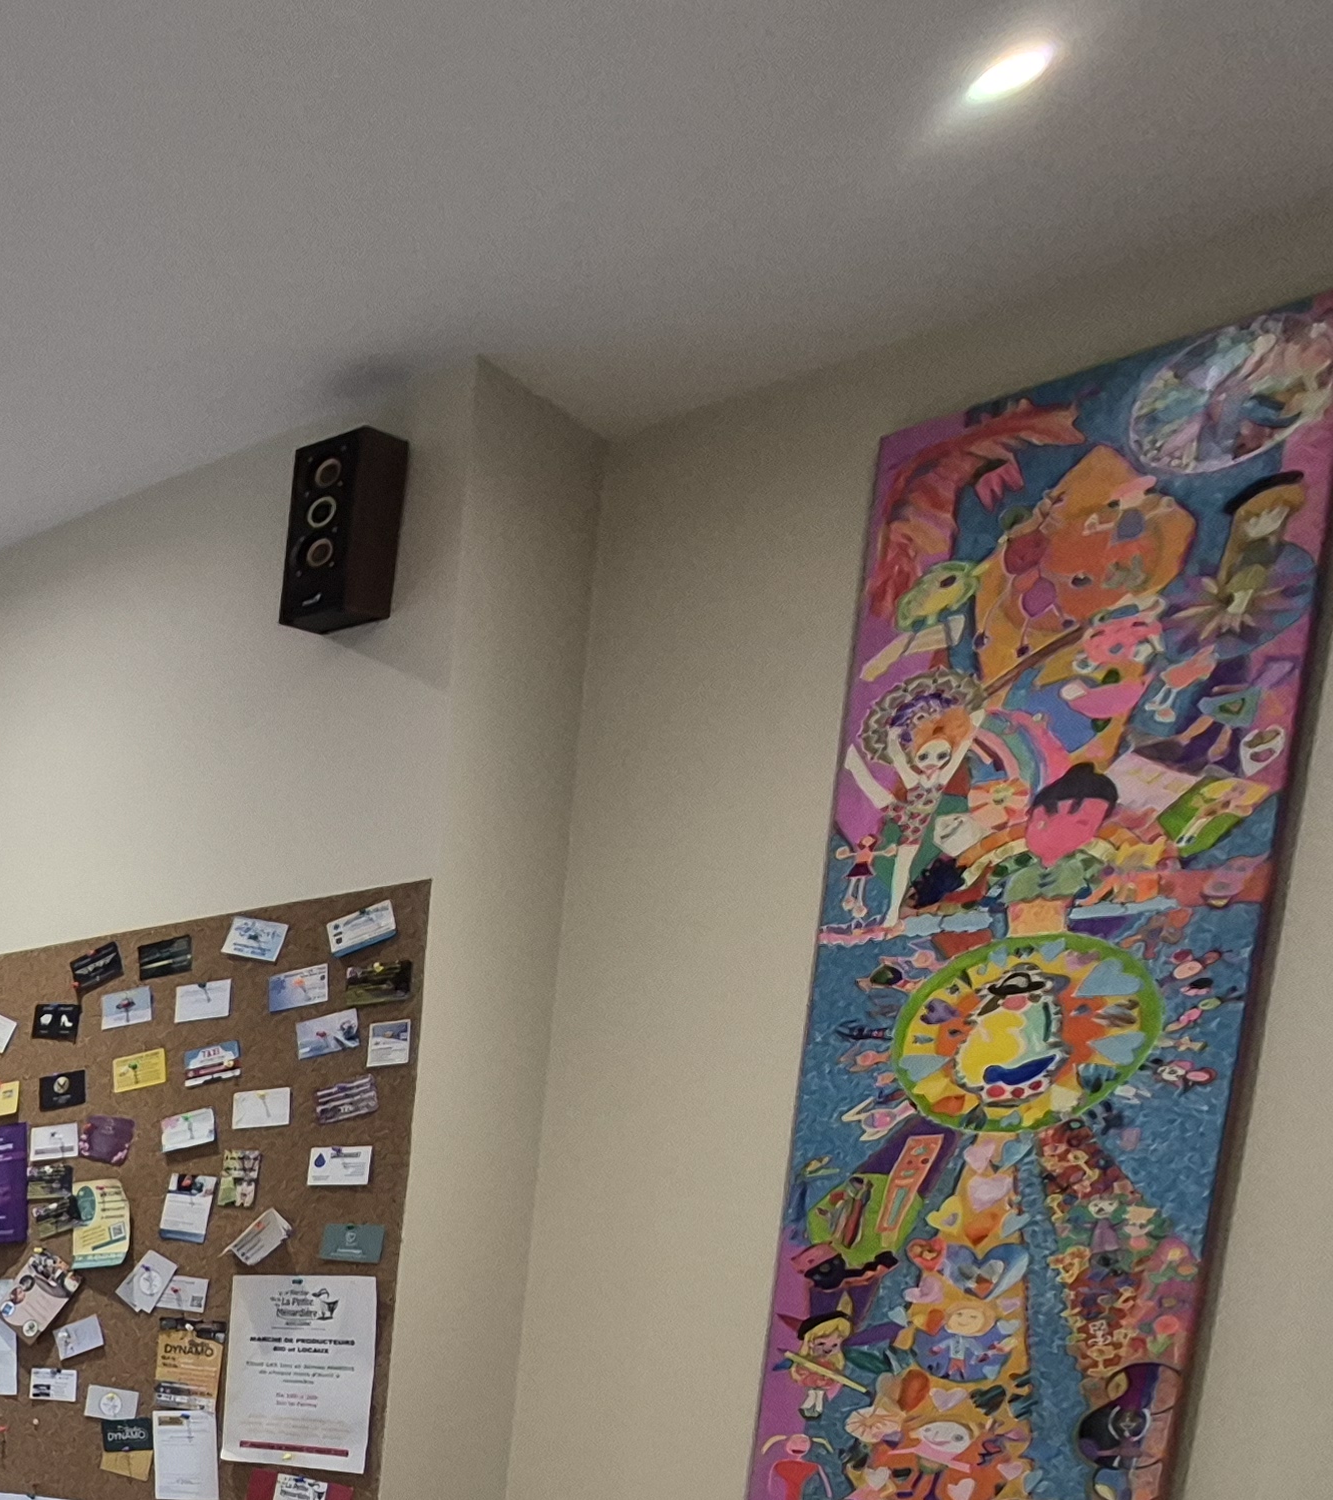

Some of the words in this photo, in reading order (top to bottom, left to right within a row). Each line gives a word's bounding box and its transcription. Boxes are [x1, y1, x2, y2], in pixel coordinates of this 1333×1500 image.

[201, 1047, 220, 1058] TAXI
[295, 1338, 356, 1346] PRODUCTEURS
[164, 1343, 214, 1357] DYNAMO
[107, 1429, 147, 1441] DYNAMO
